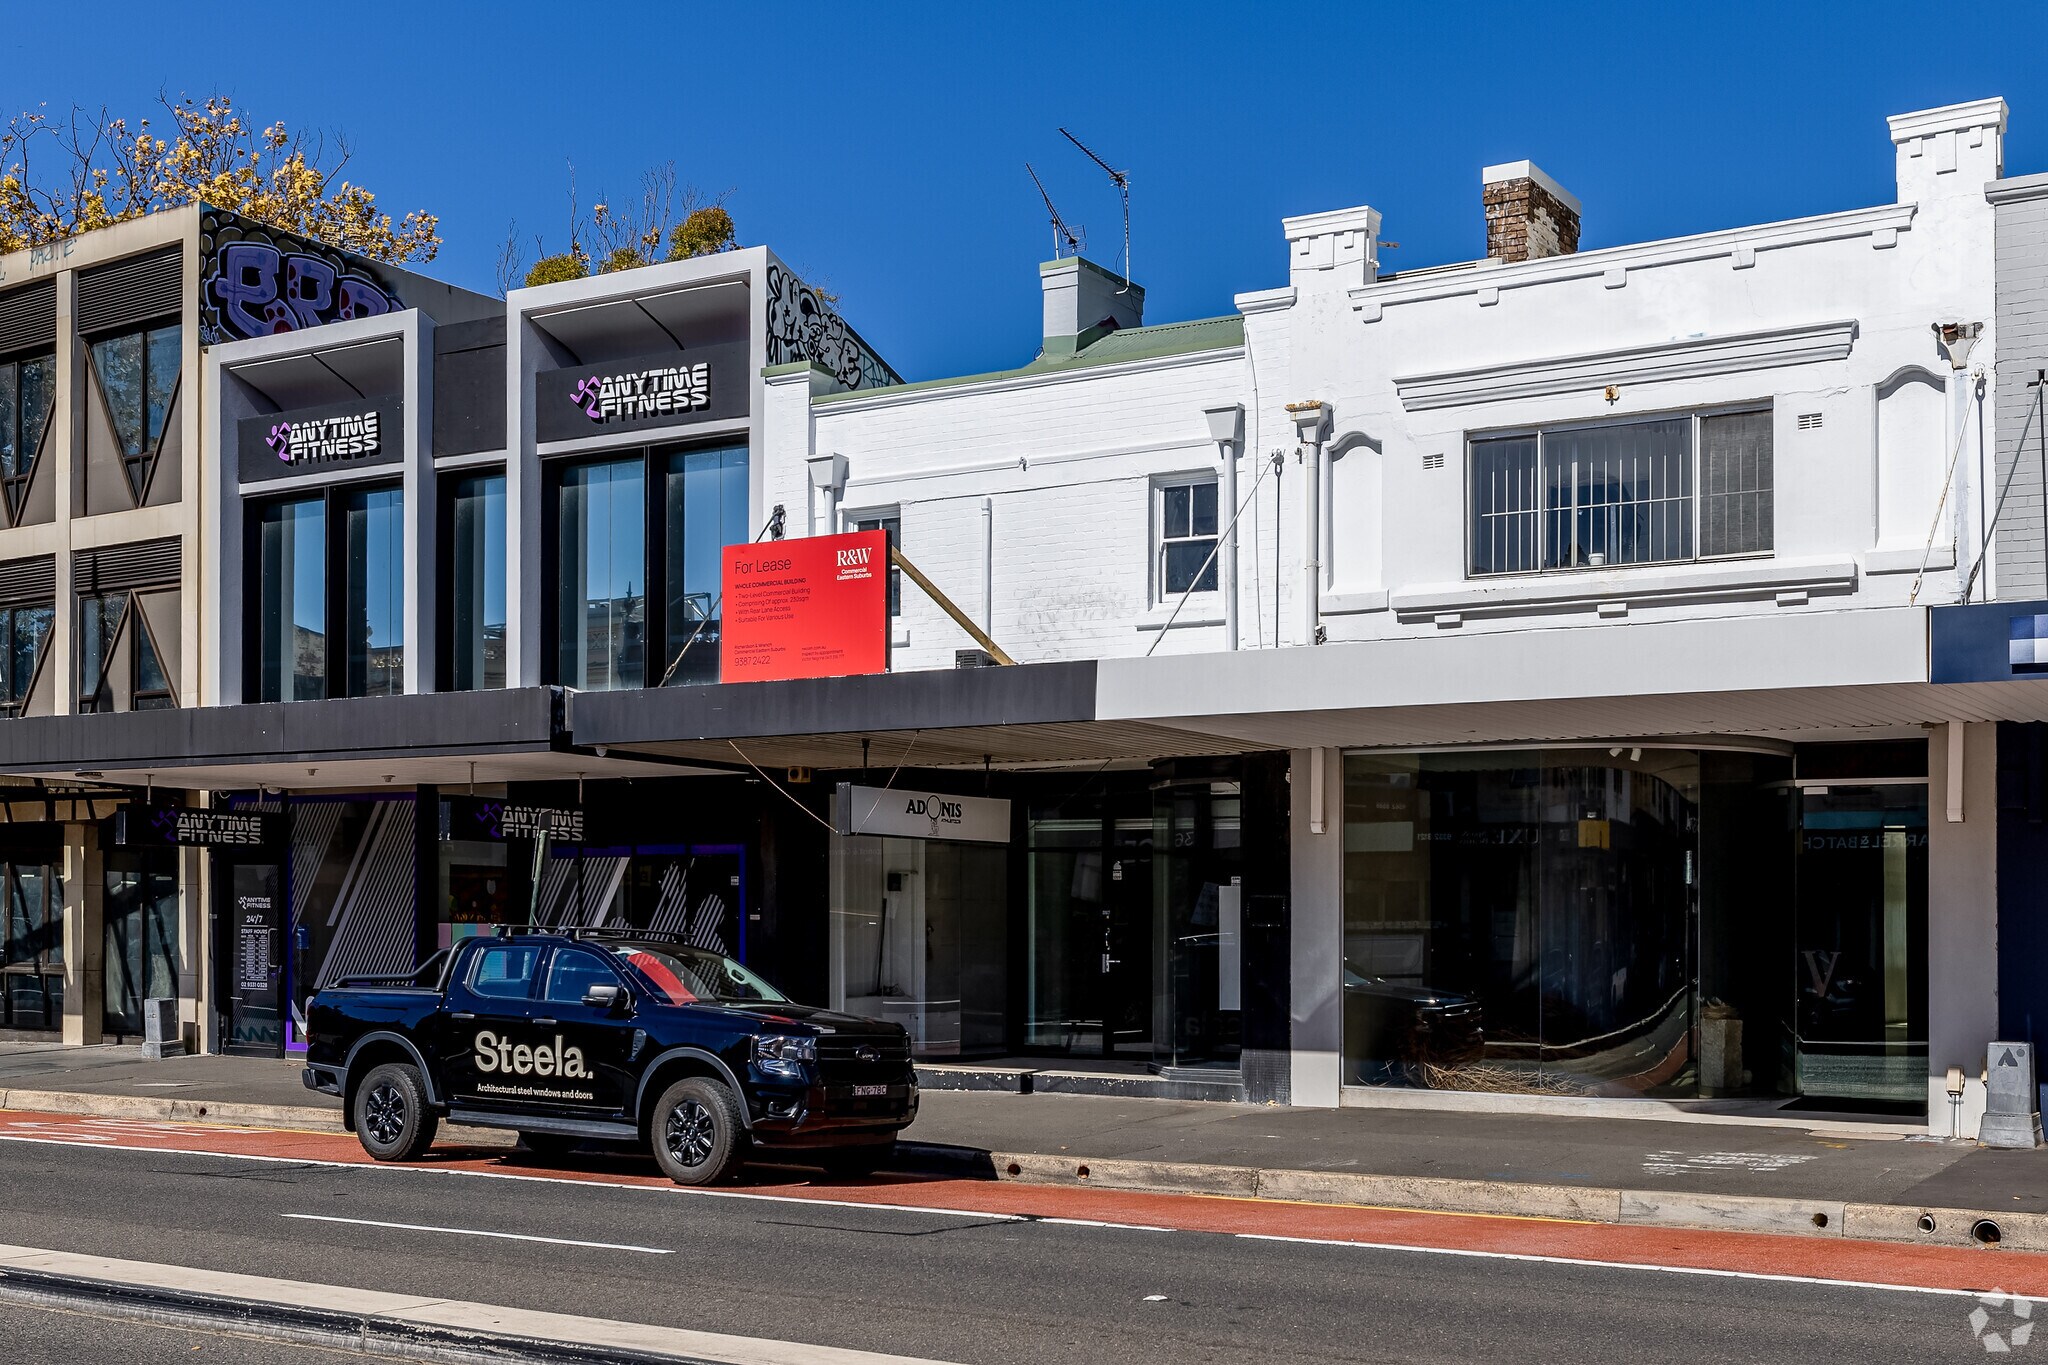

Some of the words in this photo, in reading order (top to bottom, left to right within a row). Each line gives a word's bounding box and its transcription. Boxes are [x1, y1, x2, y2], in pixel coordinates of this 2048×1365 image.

[599, 362, 708, 399] ANYTIME
[601, 386, 708, 418] FITNESS
[289, 412, 378, 444] ANYTIME
[290, 432, 378, 460] FITNESS
[735, 560, 754, 575] For
[756, 559, 792, 573] Lease
[836, 547, 873, 567] R&W
[752, 579, 784, 588] COMMERCIAL
[784, 577, 807, 585] BUILDING
[752, 655, 771, 666] 2422
[905, 794, 962, 820] ADONIS
[176, 812, 261, 831] ANYTIME
[178, 828, 261, 844] FITNESS
[474, 1030, 594, 1079] Steela.
[477, 1082, 517, 1095] Architectural
[517, 1085, 533, 1096] steel
[533, 1087, 562, 1098] windows
[562, 1089, 575, 1099] and
[574, 1089, 594, 1100] doors
